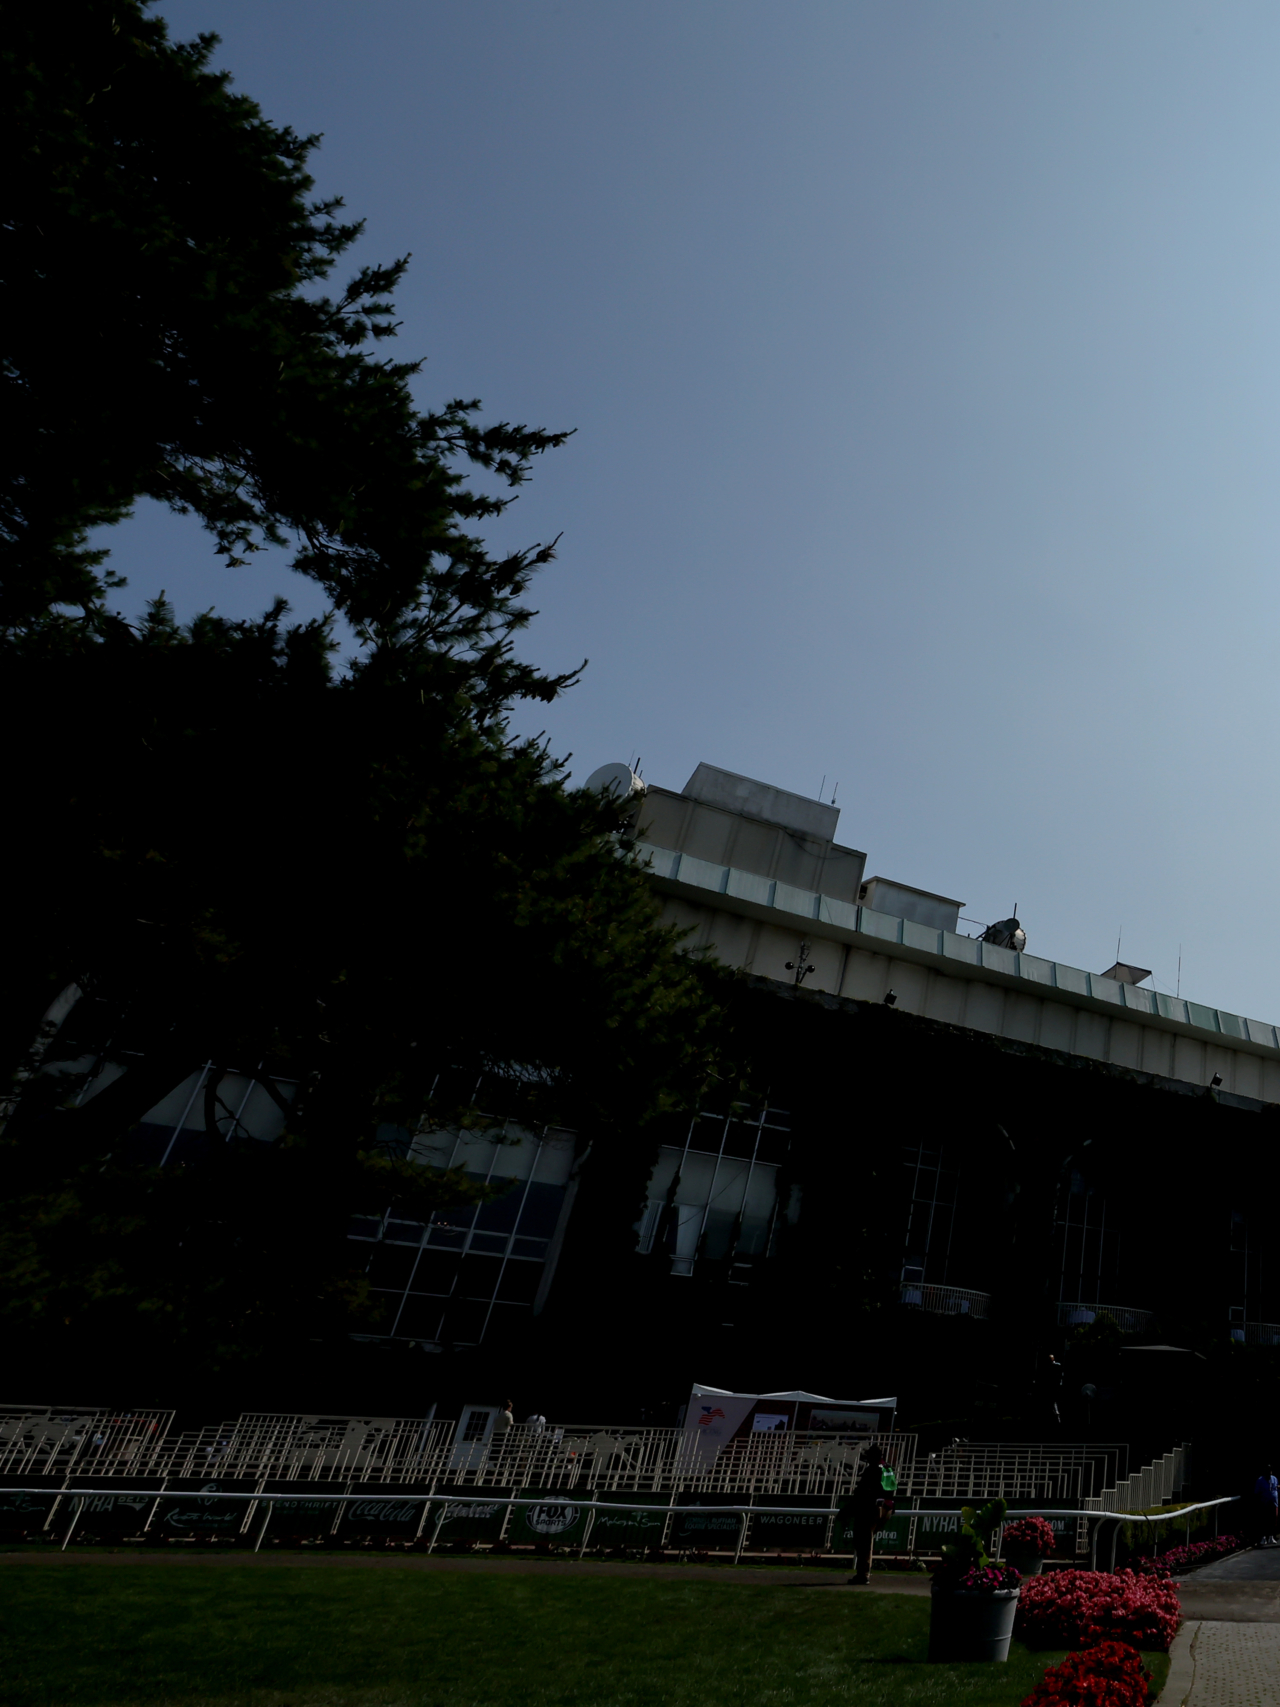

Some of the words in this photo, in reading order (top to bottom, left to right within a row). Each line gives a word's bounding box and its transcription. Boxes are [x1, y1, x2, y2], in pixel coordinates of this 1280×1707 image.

[537, 1505, 568, 1519] FOX
[535, 1518, 567, 1526] SPORTS
[760, 1515, 823, 1526] WAGONEER
